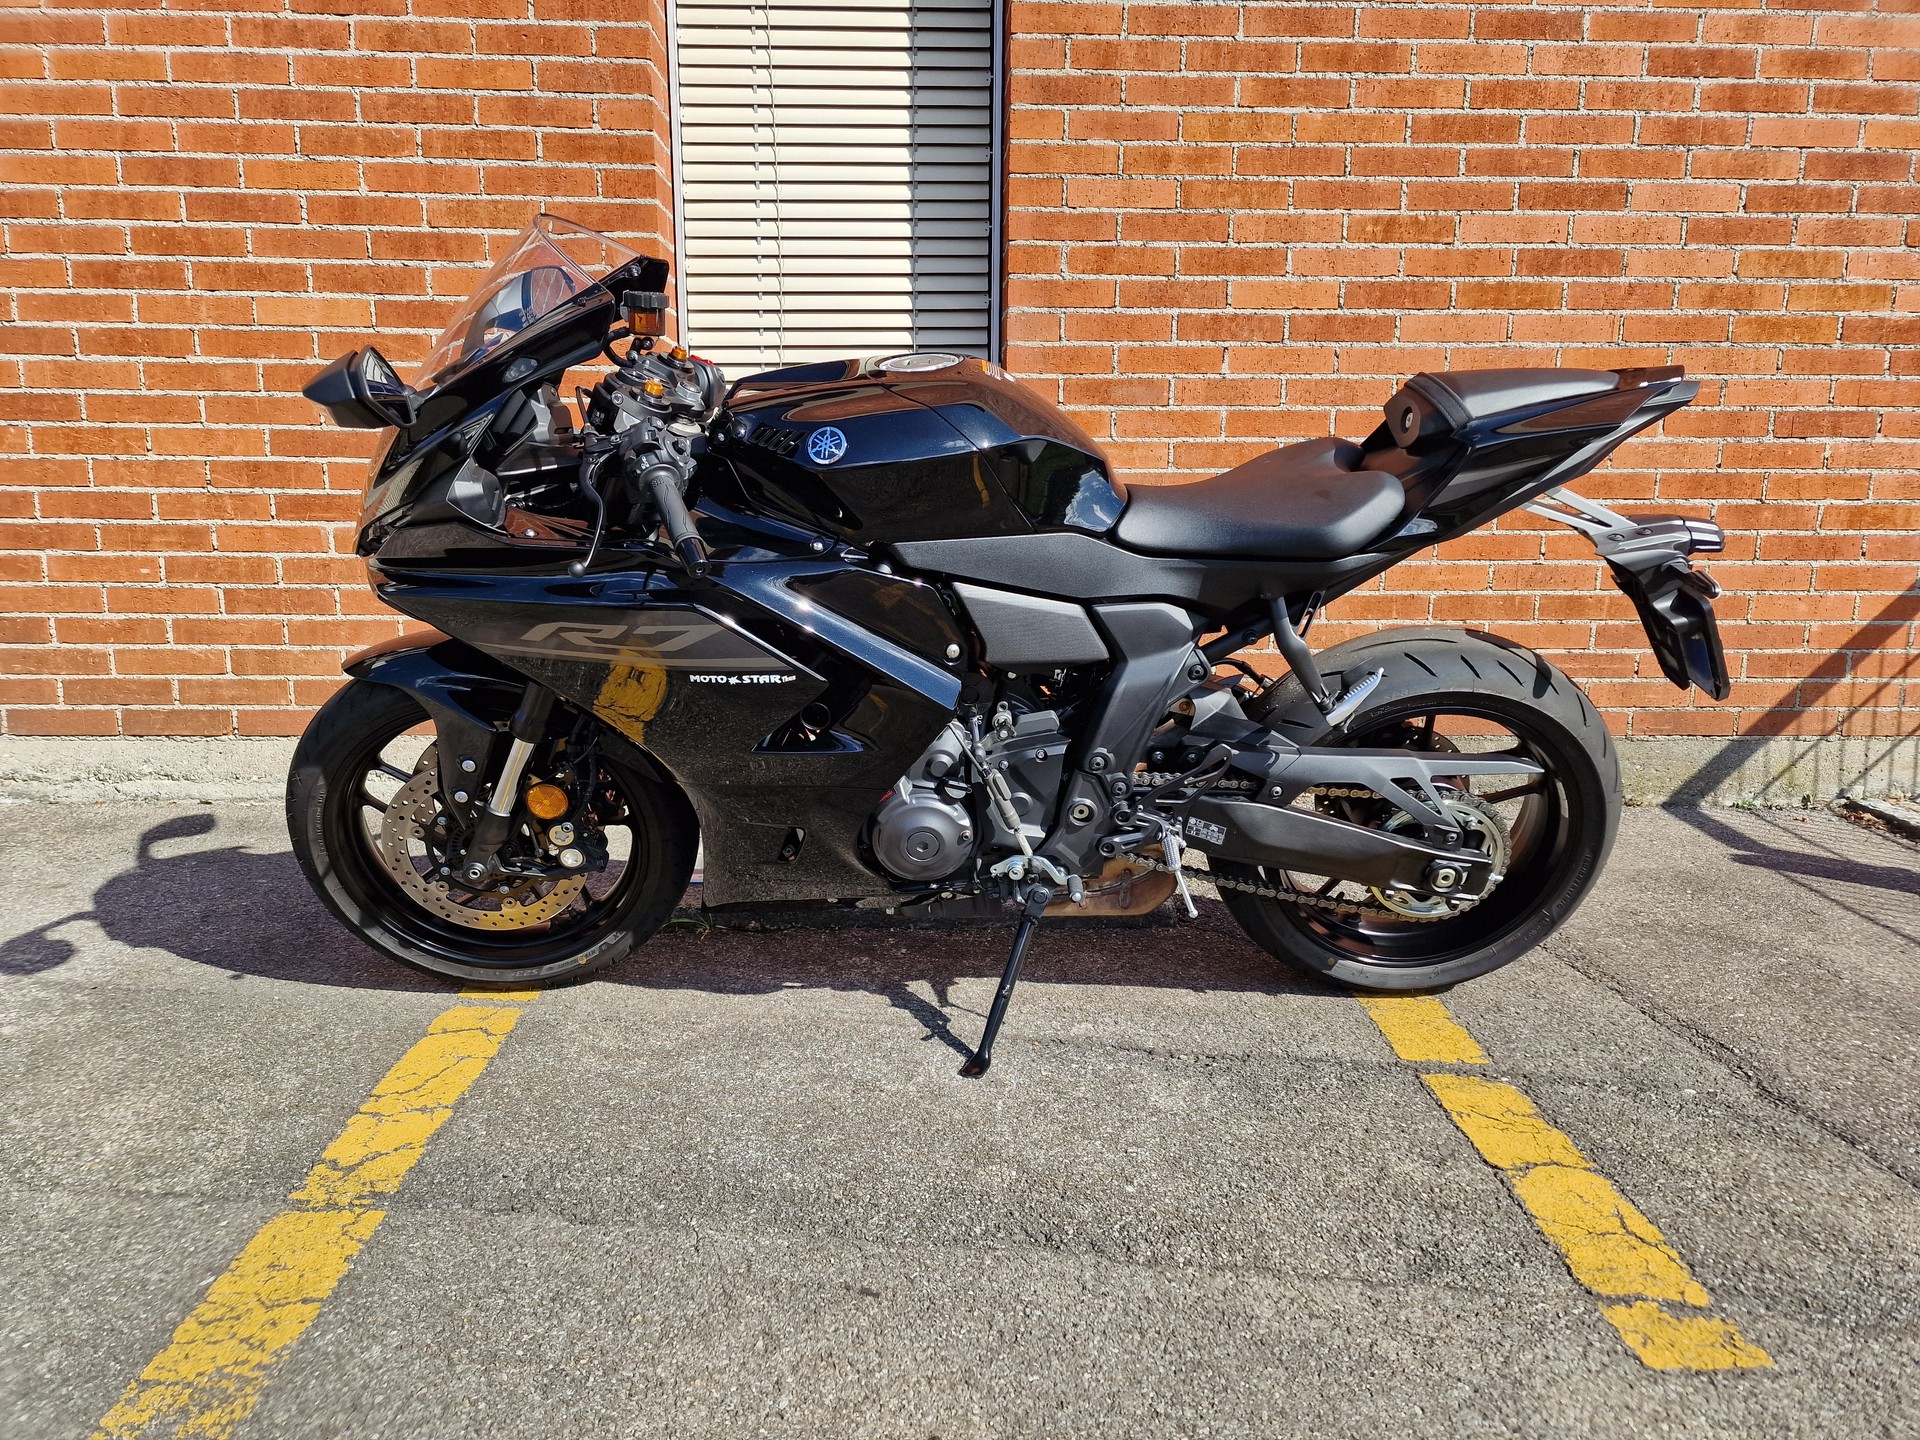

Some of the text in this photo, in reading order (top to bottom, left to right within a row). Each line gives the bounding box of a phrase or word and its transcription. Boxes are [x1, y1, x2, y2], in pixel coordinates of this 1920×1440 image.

[520, 622, 726, 651] R7
[689, 674, 727, 684] MOTO
[742, 674, 782, 684] STAR
